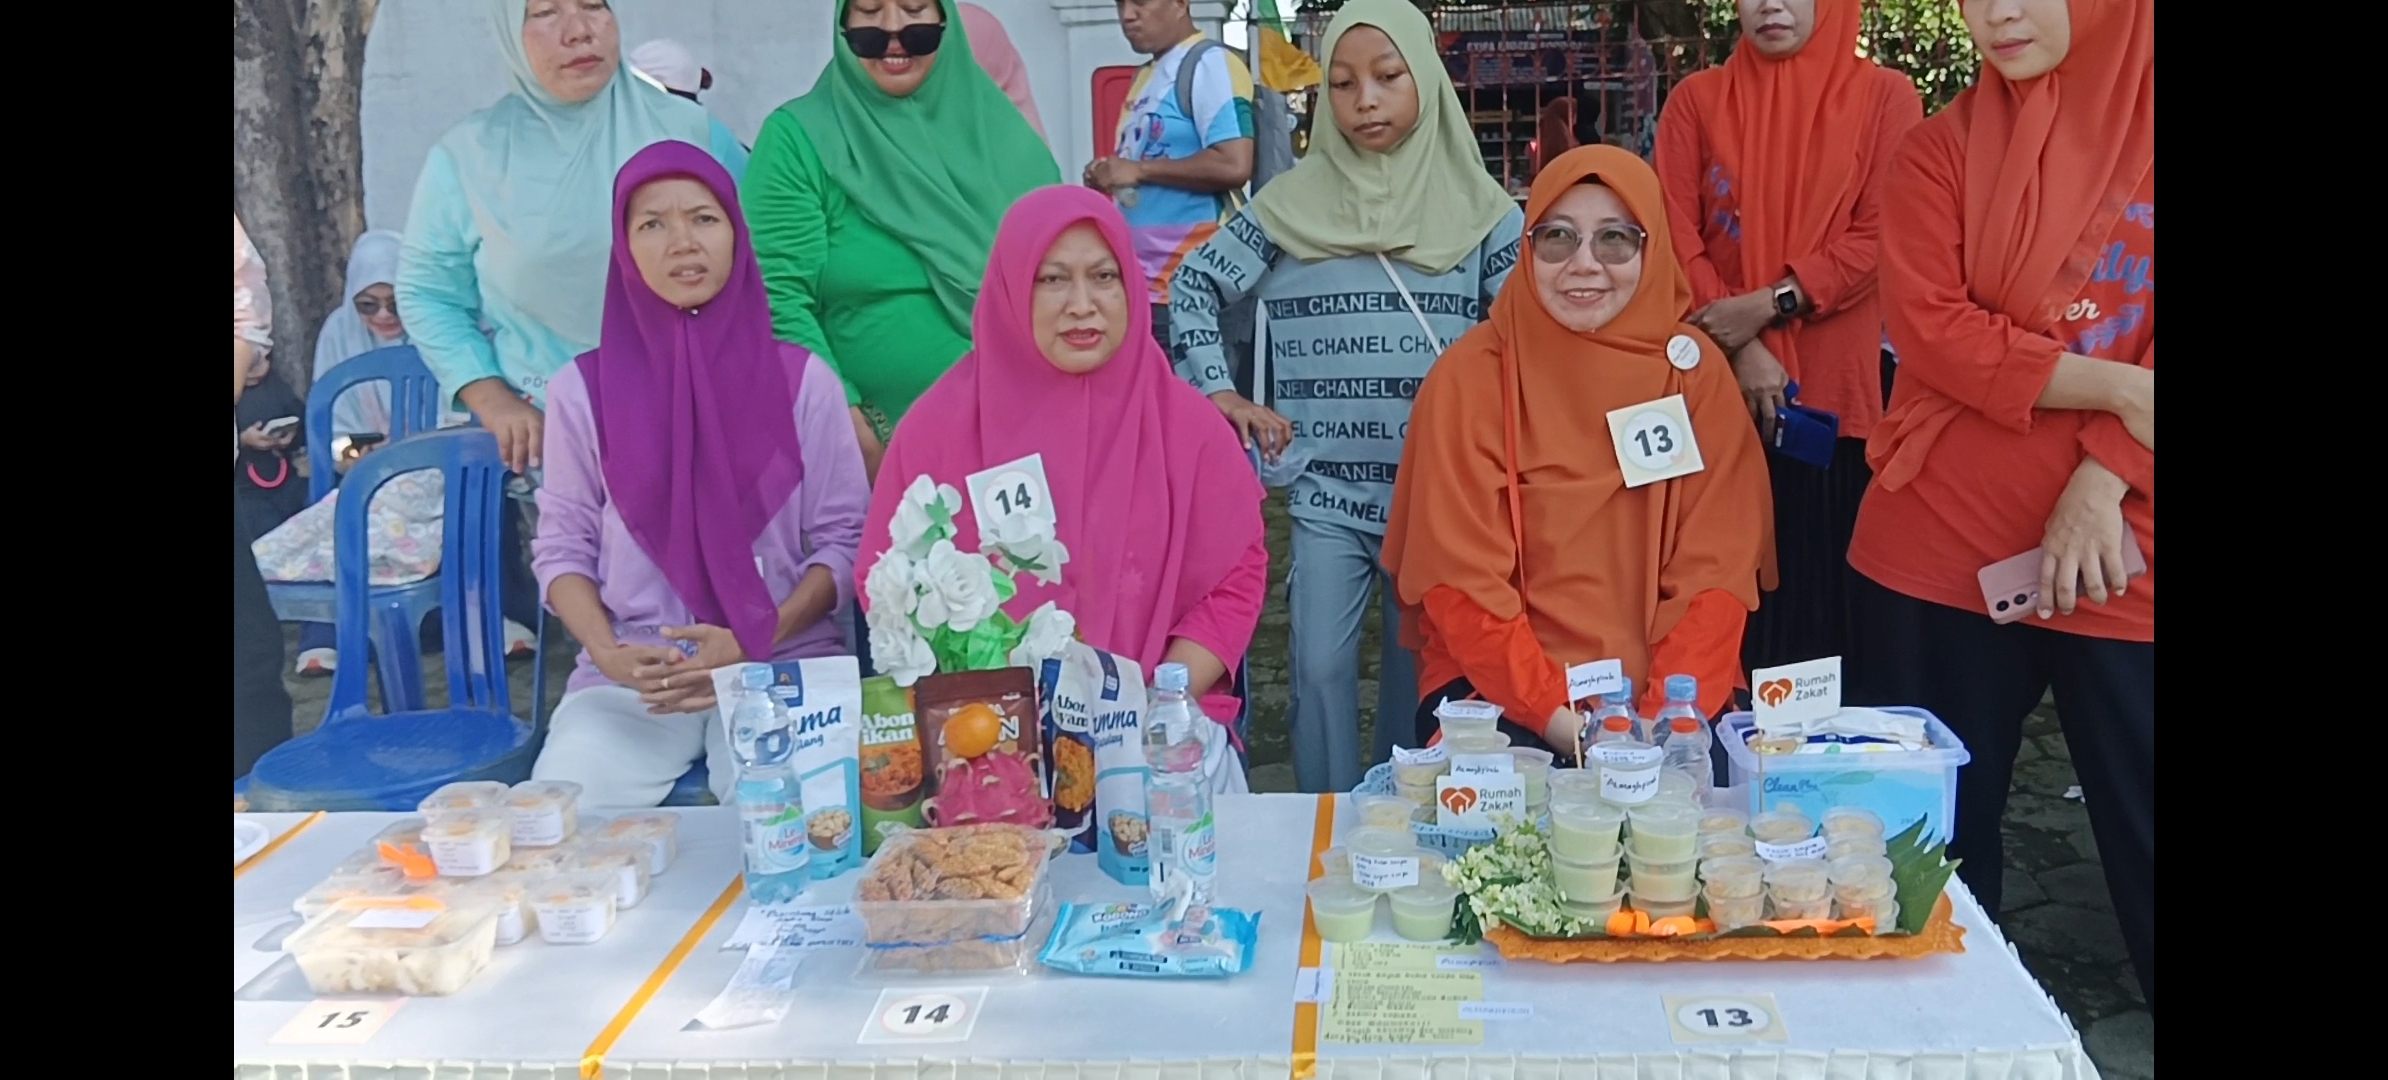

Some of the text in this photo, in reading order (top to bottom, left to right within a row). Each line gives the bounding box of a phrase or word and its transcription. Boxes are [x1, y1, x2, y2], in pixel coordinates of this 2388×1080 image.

[1308, 294, 1393, 314] CHANEL
[1312, 335, 1394, 355] CHANEL
[1313, 380, 1394, 397] CHANEL
[1312, 421, 1394, 440] CHANEL
[1635, 424, 1674, 458] 13
[1311, 462, 1393, 482] CHANEL
[994, 482, 1032, 516] 14
[1310, 491, 1388, 523] CHANEL
[1795, 672, 1837, 689] Rumah
[1795, 685, 1828, 703] Zakat
[861, 712, 915, 730] Abon
[862, 726, 915, 745] ikan
[1479, 788, 1523, 800] Rumah
[1763, 776, 1799, 793] Clean
[1479, 800, 1515, 814] Zakat
[317, 1010, 370, 1029] 15
[902, 1003, 951, 1024] 14
[1696, 1008, 1753, 1028] 13
